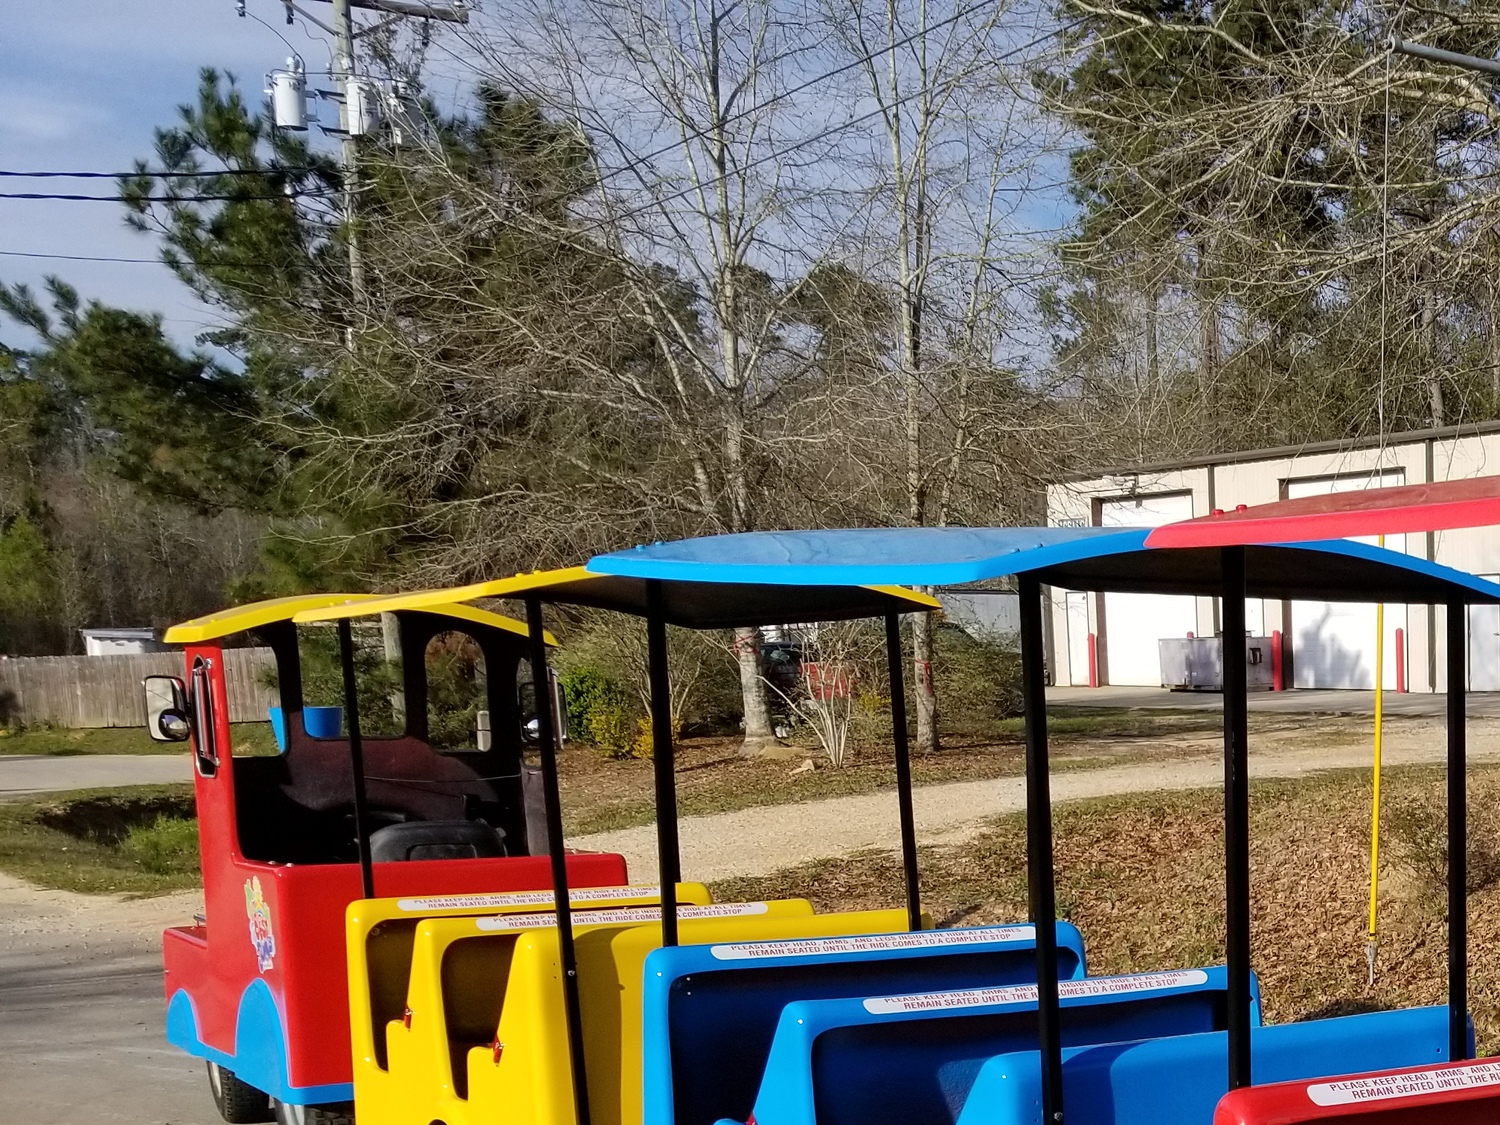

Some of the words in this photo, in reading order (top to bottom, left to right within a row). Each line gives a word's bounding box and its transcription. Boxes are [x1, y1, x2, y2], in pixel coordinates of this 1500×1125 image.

[749, 948, 785, 956] REMAIN
[787, 946, 821, 954] SEATED
[892, 939, 923, 947] COMES
[945, 935, 988, 943] COMPLETE
[885, 995, 923, 1003] PLEASE
[904, 1000, 942, 1009] REMAIN
[945, 996, 980, 1006] SEATED
[982, 994, 1010, 1002] UNTIL
[1011, 992, 1030, 1000] THE
[1059, 987, 1086, 995] OMES
[1110, 980, 1155, 991] COMPLETE
[1156, 978, 1178, 987] STOP
[1329, 1080, 1370, 1091] PLEASE
[1372, 1076, 1398, 1086] KEEP
[1470, 1064, 1491, 1073] AND
[1352, 1086, 1392, 1099] REMAIN
[1396, 1081, 1434, 1093] SEATED
[1436, 1076, 1467, 1088] UNTIL
[1469, 1073, 1488, 1083] THE
